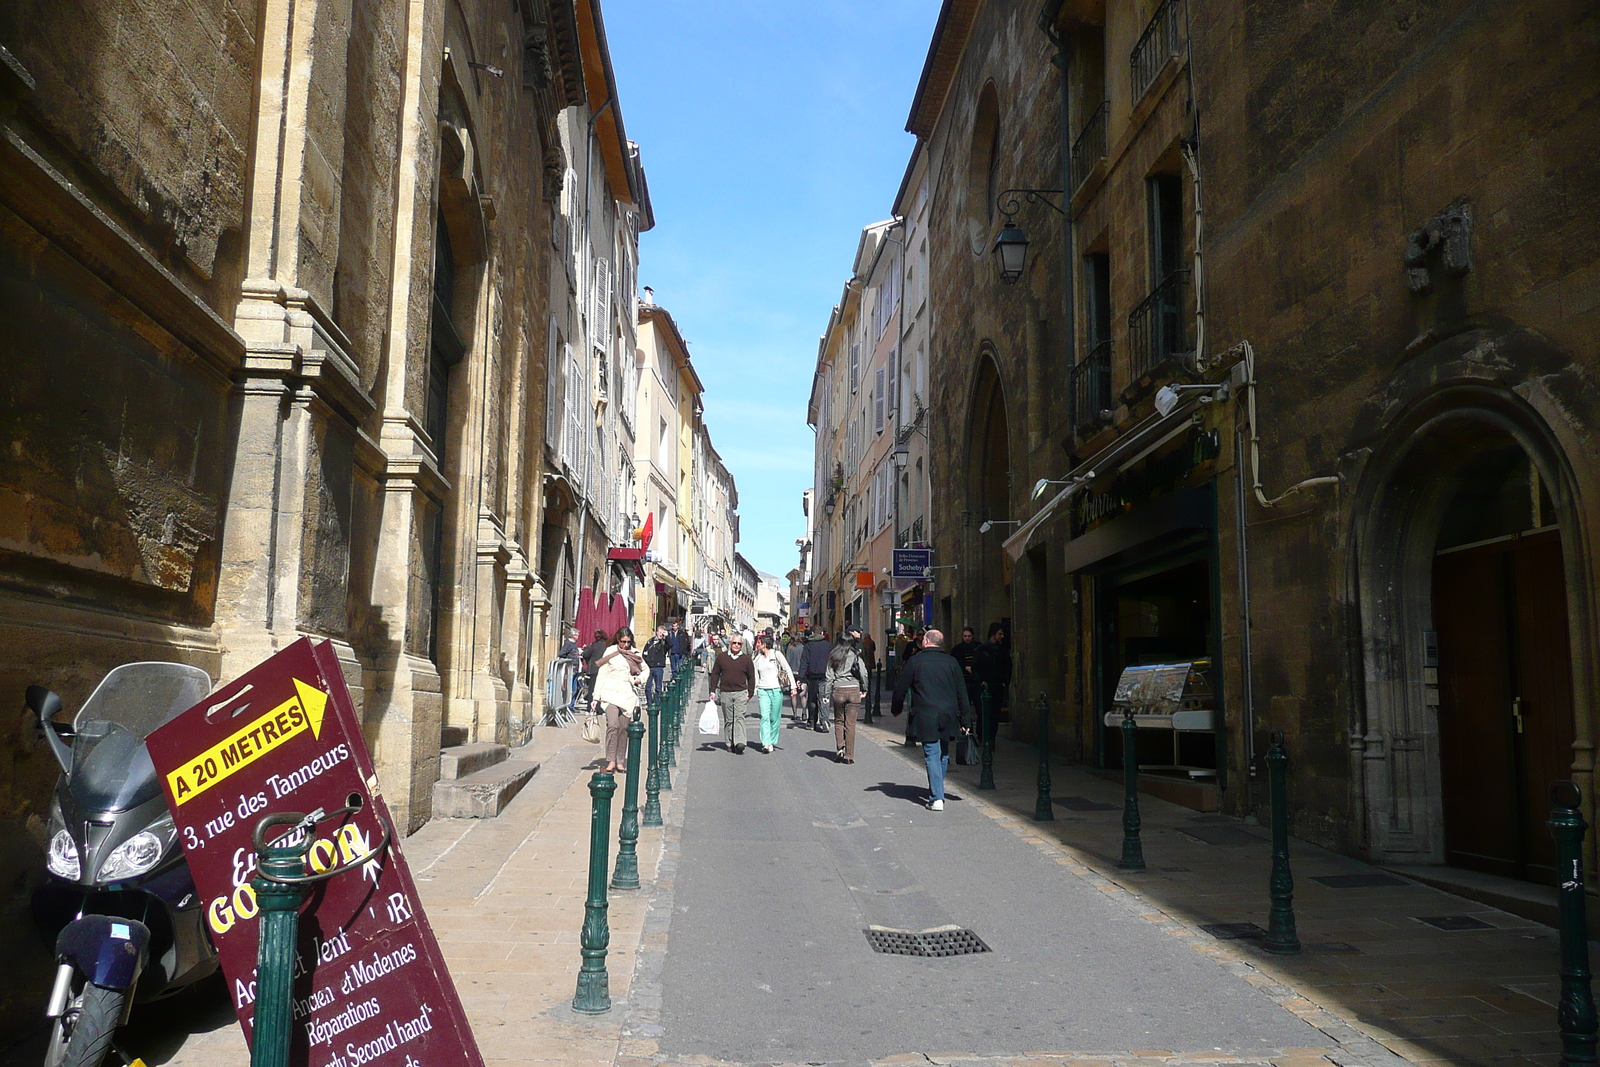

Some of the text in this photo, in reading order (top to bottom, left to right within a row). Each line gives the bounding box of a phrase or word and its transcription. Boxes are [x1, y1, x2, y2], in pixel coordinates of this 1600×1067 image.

[175, 704, 304, 799] A 20 METRES
[183, 742, 349, 850] 3, rue des Tanneurs
[341, 971, 355, 995] et
[304, 996, 381, 1047] Réparations
[347, 1023, 399, 1067] Second
